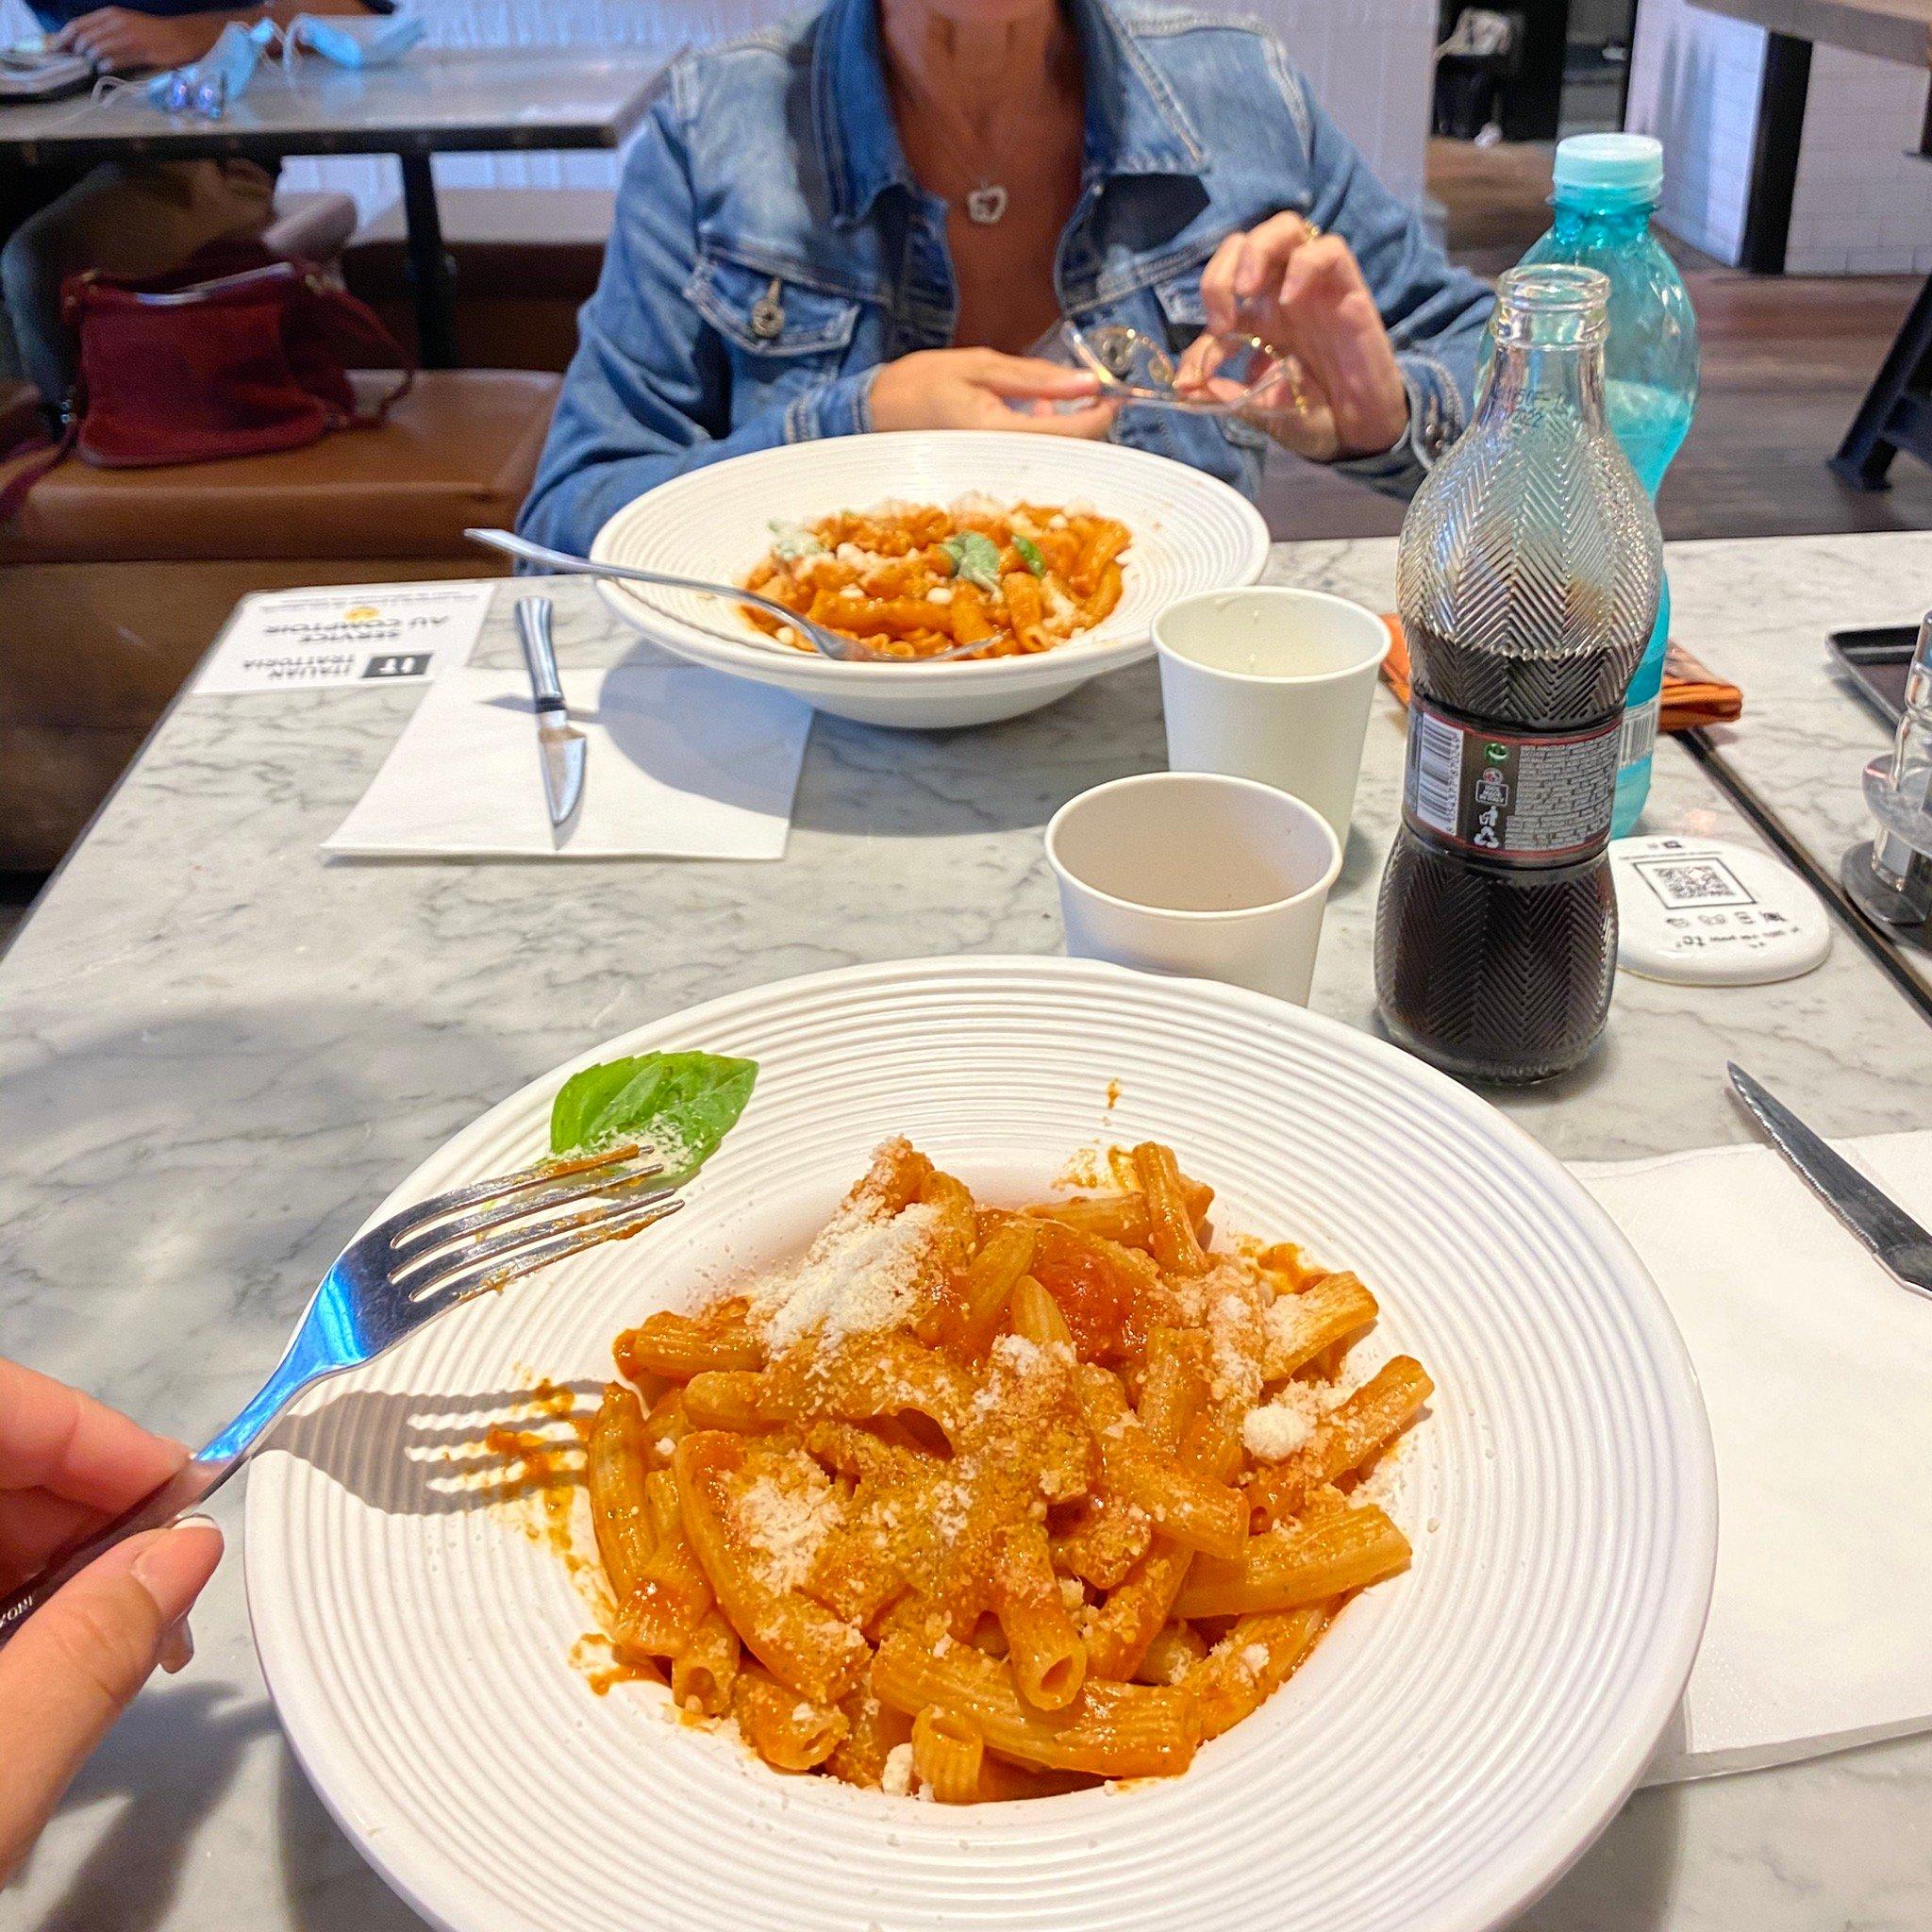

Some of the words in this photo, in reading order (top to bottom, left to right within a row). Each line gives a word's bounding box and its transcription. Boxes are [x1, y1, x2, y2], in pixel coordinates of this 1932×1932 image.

[265, 620, 402, 635] COMPTOIR
[299, 632, 401, 644] SERVICE
[242, 654, 355, 669] TRATTORIA
[378, 657, 416, 674] IT
[268, 666, 353, 680] ITALIAN
